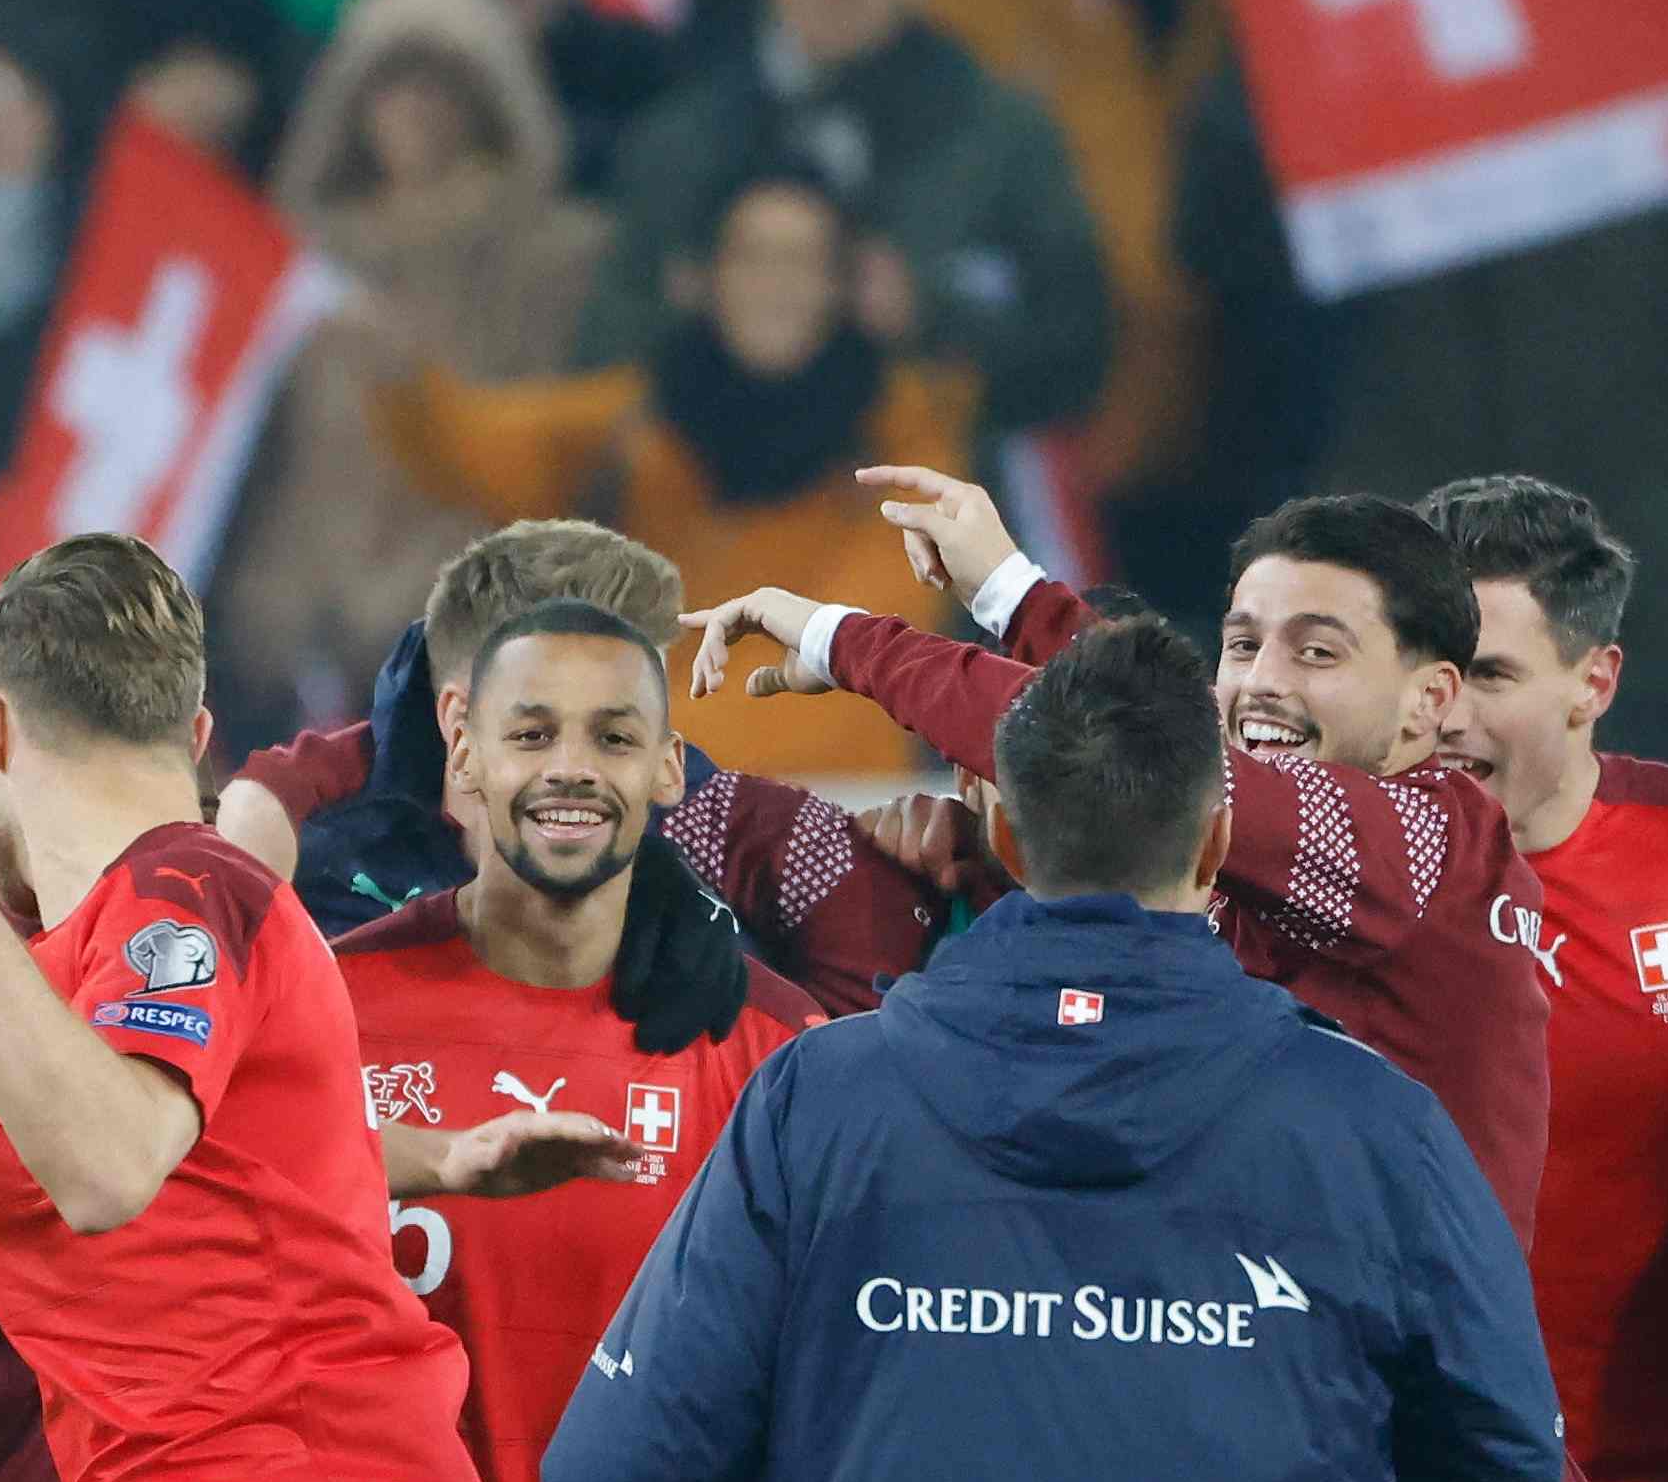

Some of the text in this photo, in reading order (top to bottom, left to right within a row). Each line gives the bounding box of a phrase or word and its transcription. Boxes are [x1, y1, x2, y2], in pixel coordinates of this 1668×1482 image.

[130, 1007, 209, 1038] RESPEC
[855, 1276, 1256, 1349] CREDIT SUISSE
